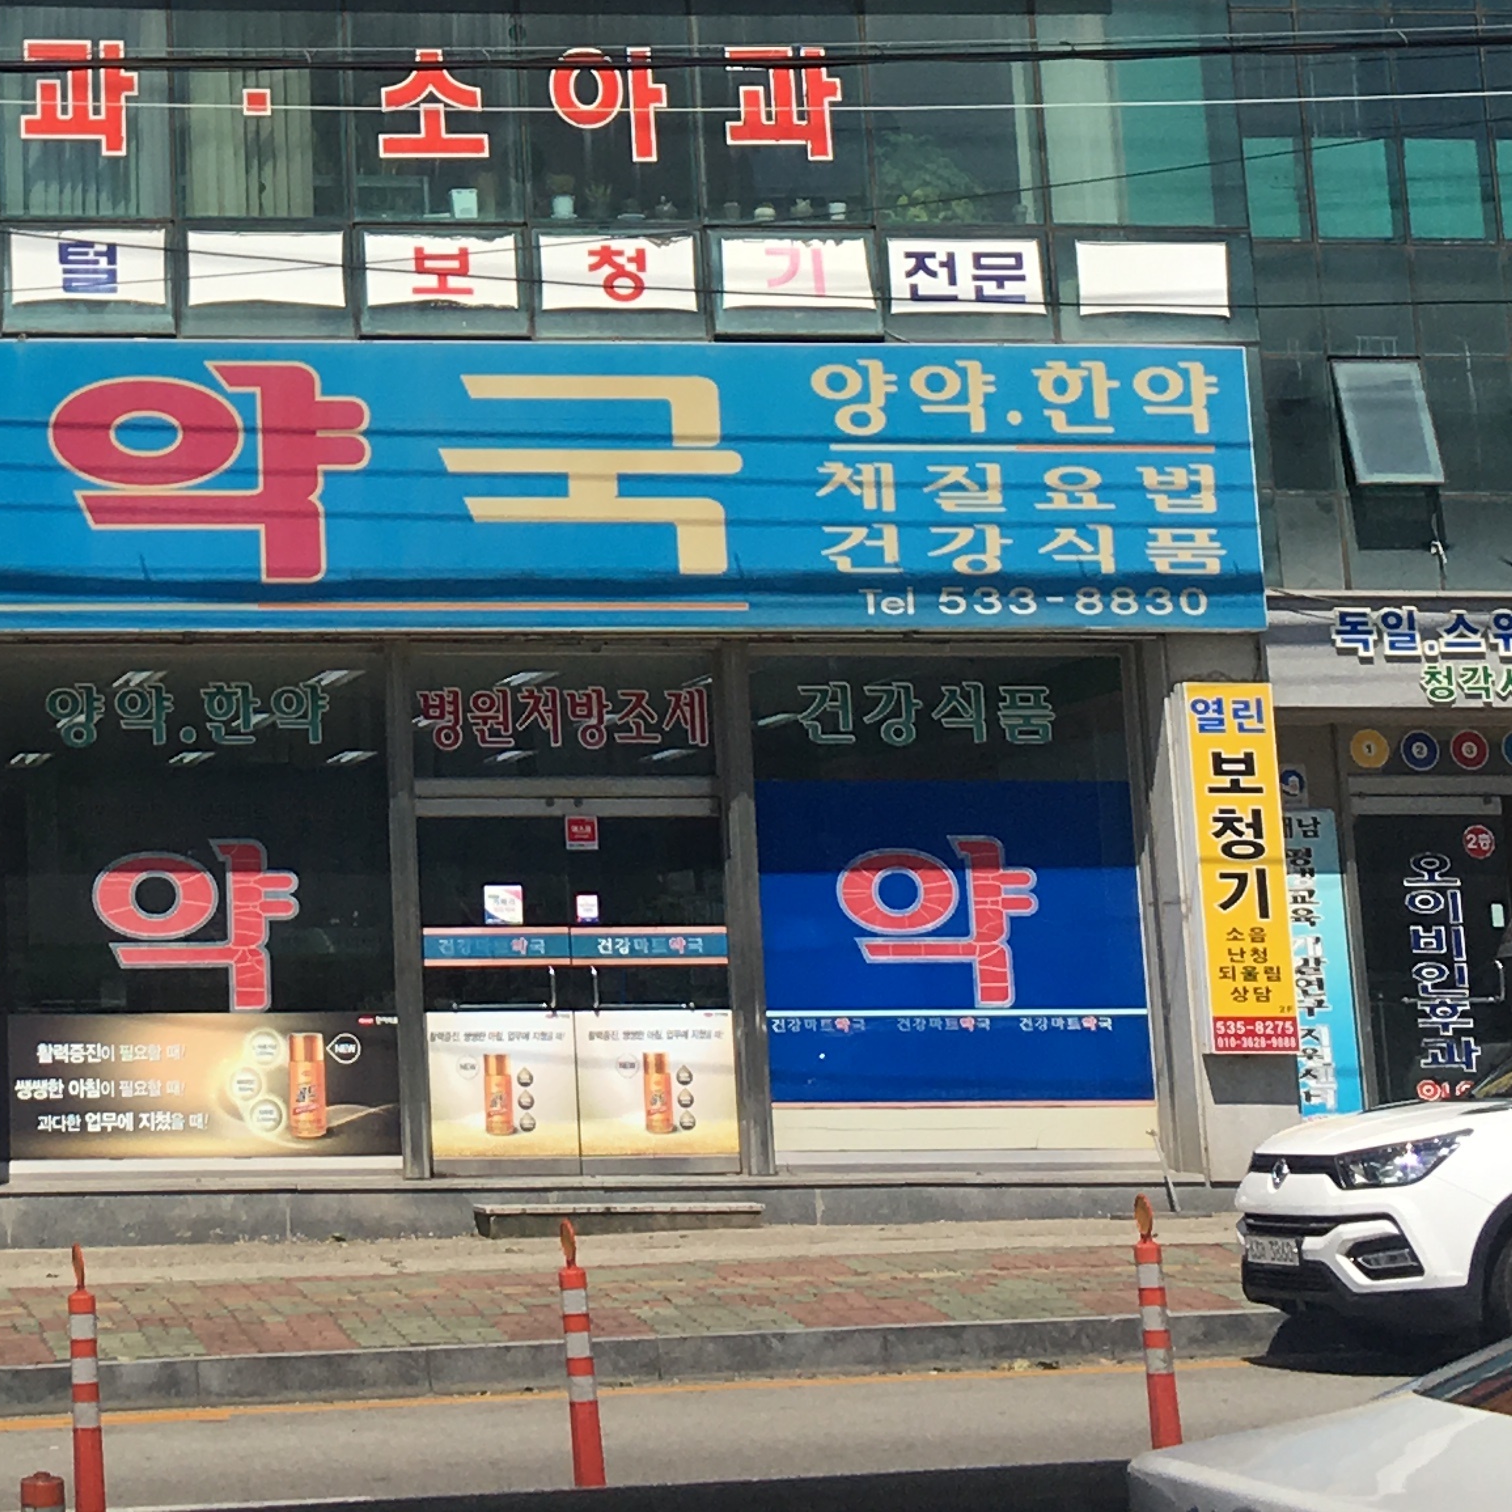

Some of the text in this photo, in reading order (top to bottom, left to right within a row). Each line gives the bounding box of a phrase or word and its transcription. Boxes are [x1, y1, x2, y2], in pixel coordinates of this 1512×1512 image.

[902, 250, 1027, 302] 전문
[816, 462, 1218, 514] 체질요법
[821, 524, 1227, 575] 건강식품
[859, 587, 1209, 616] Tel 533-8830
[416, 686, 710, 750] 병원처방조제
[797, 681, 1057, 747] 건강식품
[1190, 697, 1267, 735] 열린
[1207, 750, 1272, 921] 보청기
[92, 838, 300, 1013] 약
[836, 834, 1039, 1008] 약
[1226, 927, 1266, 943] 소음
[1228, 947, 1268, 964] 난청
[1404, 852, 1481, 1073] 오이비인후과
[1231, 986, 1272, 1003] 상담
[1215, 1020, 1294, 1035] 535-8275
